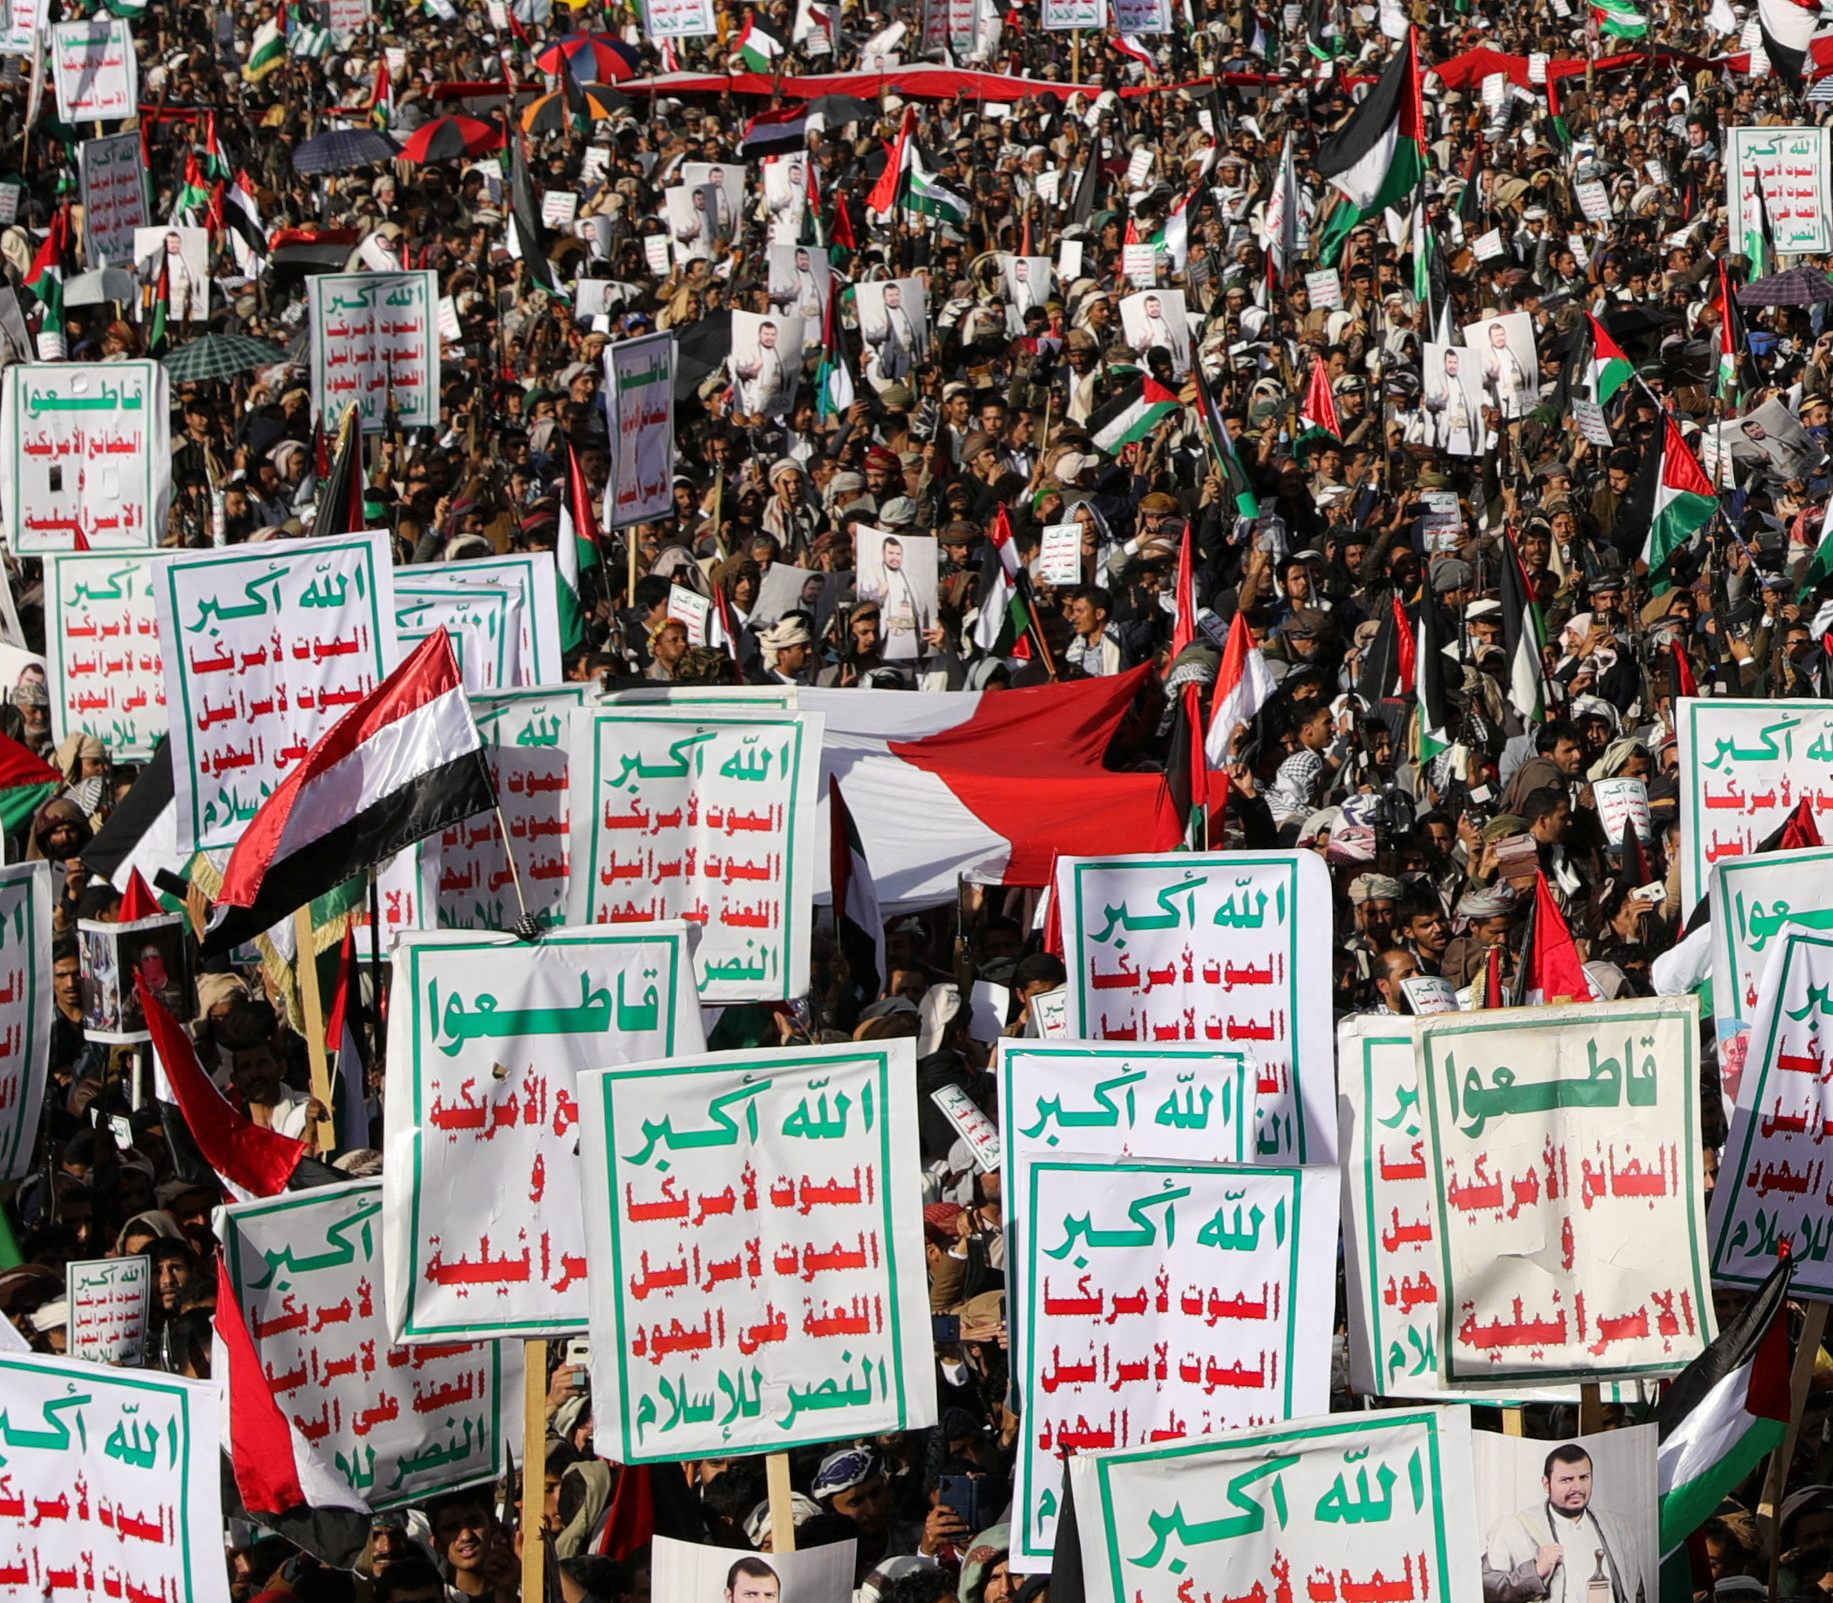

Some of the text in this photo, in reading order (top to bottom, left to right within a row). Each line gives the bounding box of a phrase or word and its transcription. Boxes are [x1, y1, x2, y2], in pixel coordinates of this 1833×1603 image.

[187, 565, 365, 636] الله أكبر
[292, 627, 367, 665] الموت
[607, 728, 789, 793] الله أكبر
[706, 806, 782, 836] الموت
[704, 855, 780, 885] الموت
[1447, 1041, 1655, 1138] قاطعوا
[624, 1078, 874, 1172] الله أكبر
[770, 1167, 874, 1215] الموت
[1447, 1140, 1678, 1222] البضائع الأمريكية
[1746, 1161, 1825, 1198] اليهود
[1044, 1183, 1285, 1269] الله أكبر
[1562, 1217, 1574, 1270] و
[774, 1232, 879, 1282] الموت
[633, 1296, 883, 1365] اللعنة على اليهود
[1181, 1284, 1279, 1327] الموت
[1458, 1290, 1694, 1361] الإسرائيلية
[637, 1352, 887, 1441] النصر للإسلام
[1179, 1352, 1276, 1395] الموت
